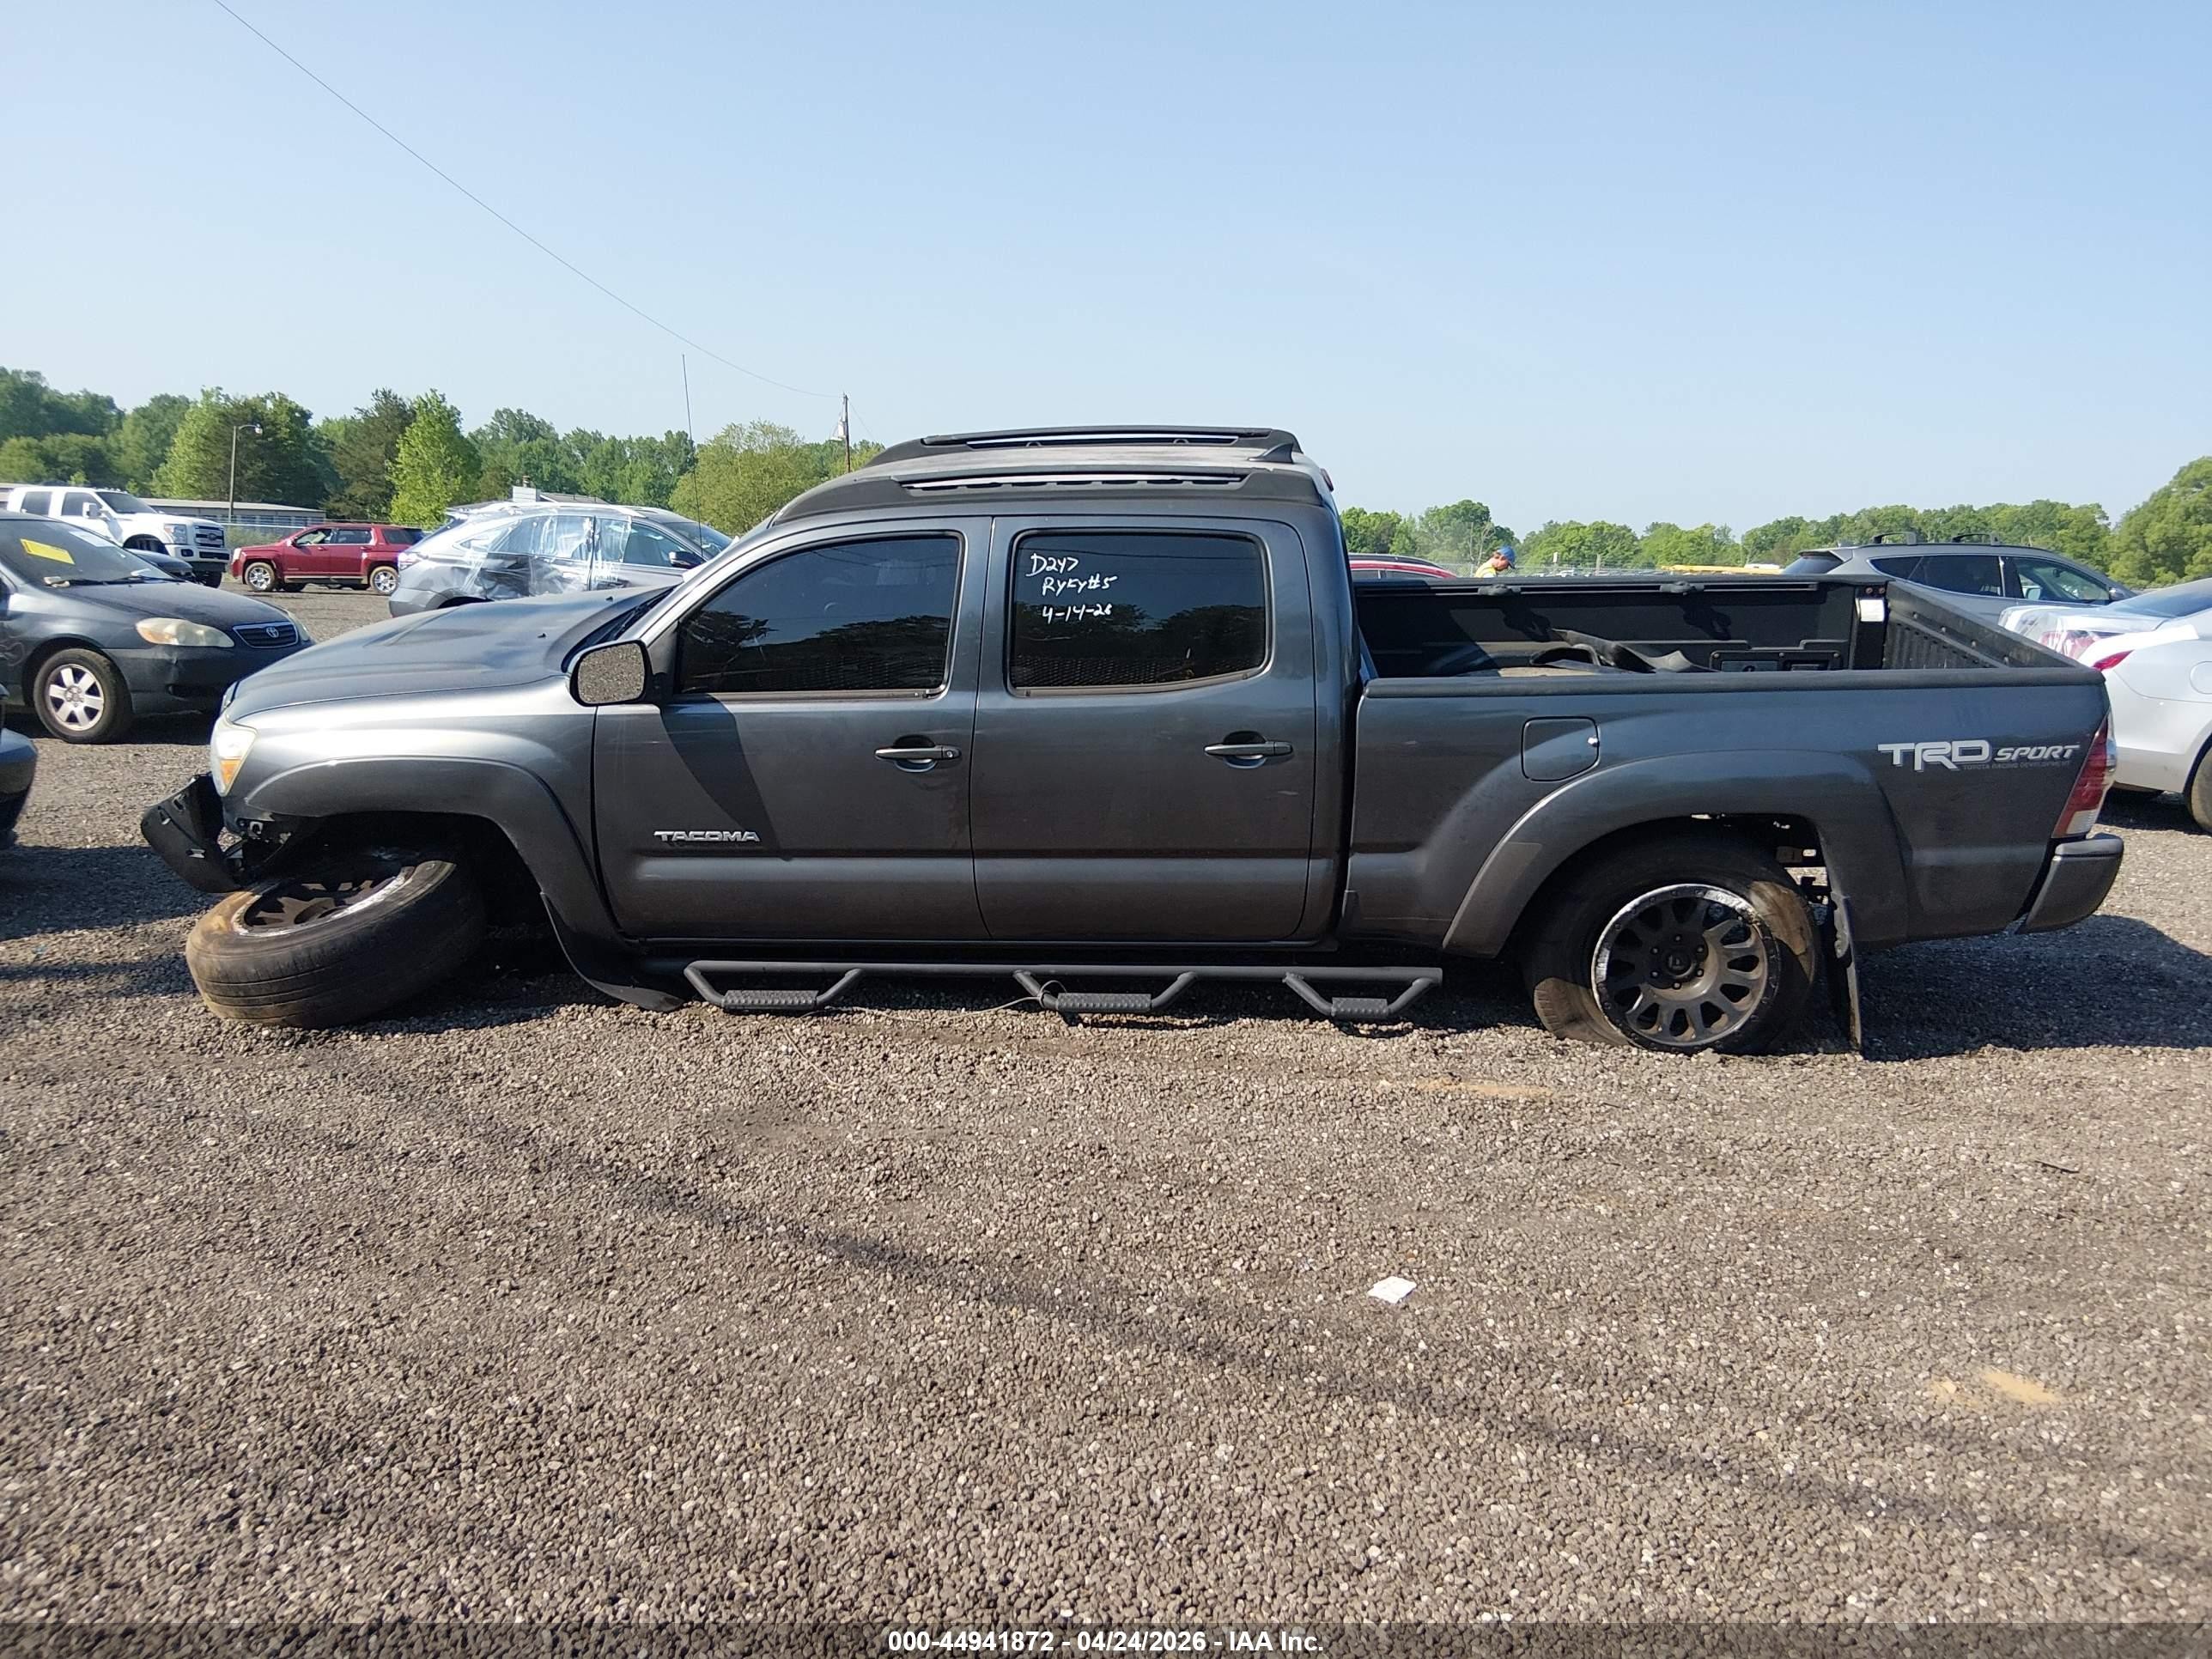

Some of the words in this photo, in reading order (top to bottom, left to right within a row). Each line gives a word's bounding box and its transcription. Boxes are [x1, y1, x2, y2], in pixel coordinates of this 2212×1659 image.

[1877, 739, 1990, 773] TRD
[1993, 744, 2081, 763] SPORT
[653, 830, 760, 842] TACOMA
